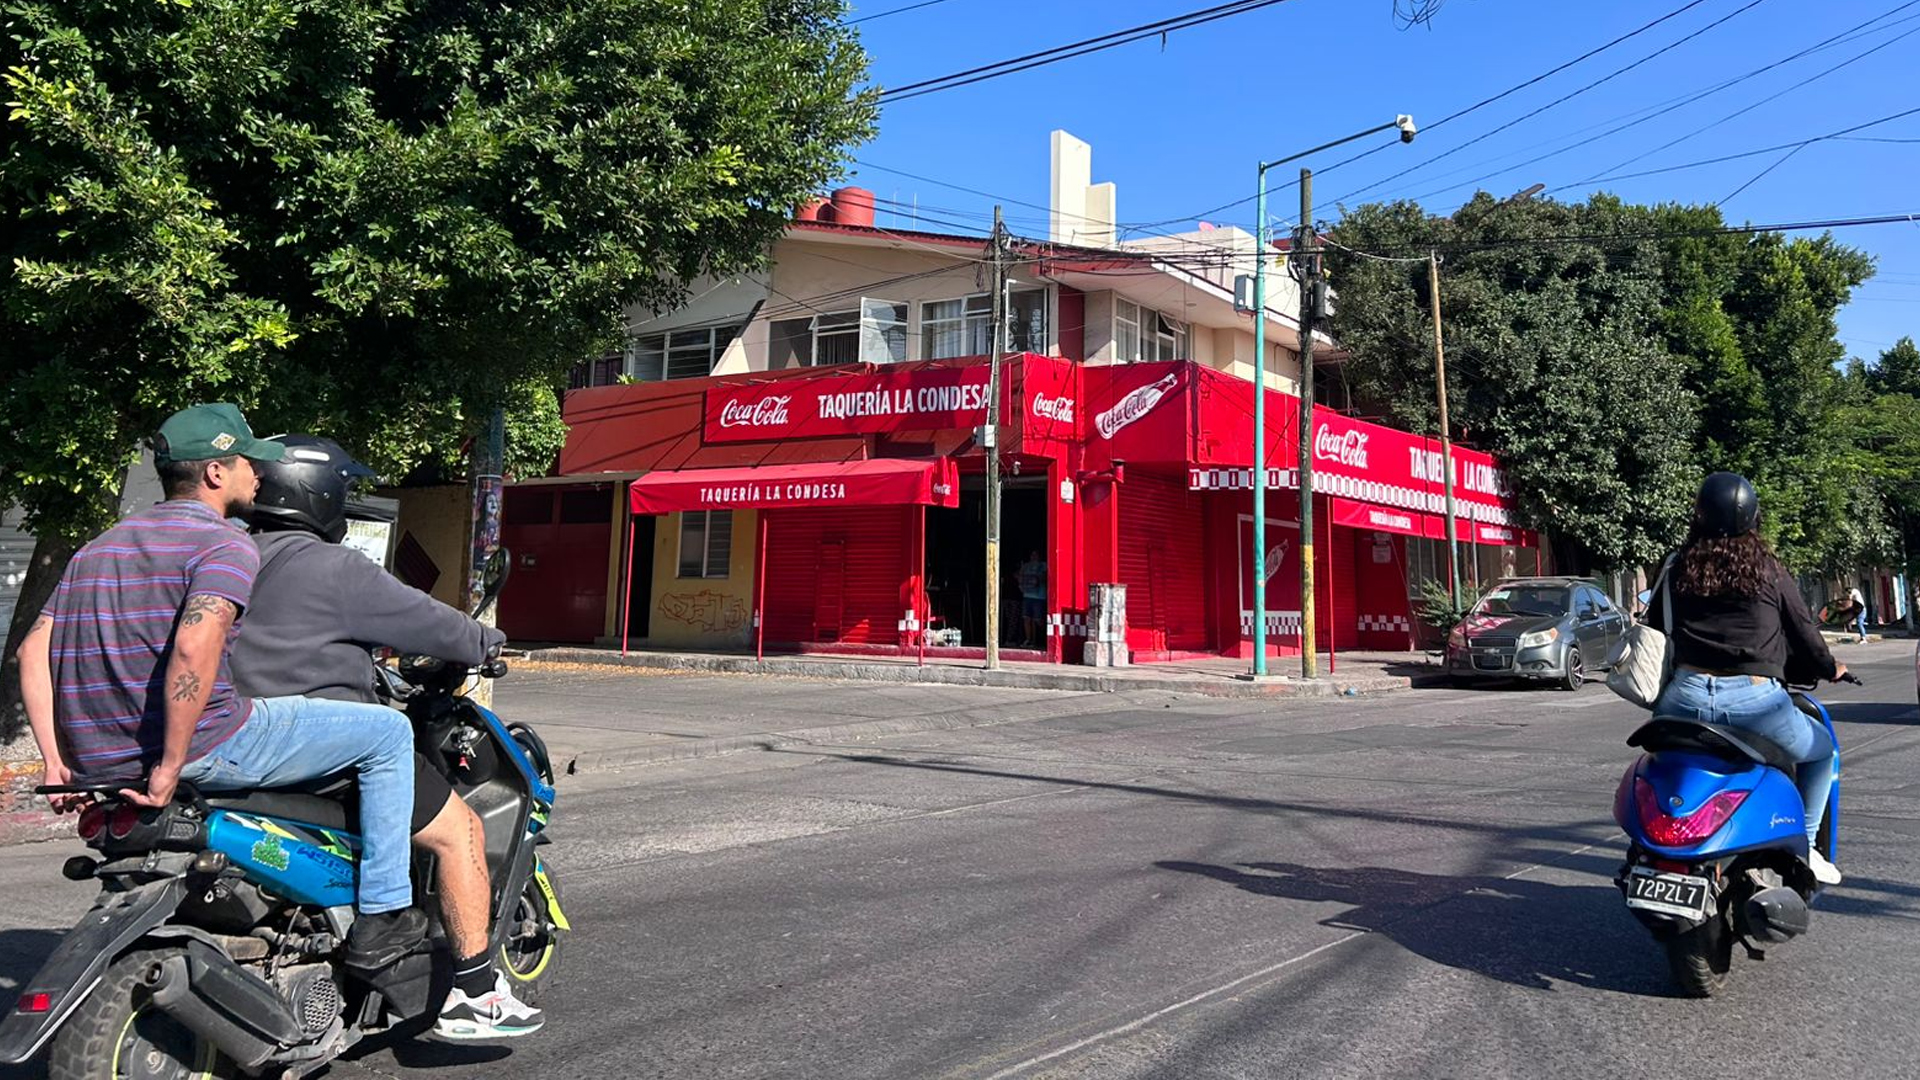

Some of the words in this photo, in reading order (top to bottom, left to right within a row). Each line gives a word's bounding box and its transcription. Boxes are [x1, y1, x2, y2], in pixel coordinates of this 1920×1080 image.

[720, 395, 792, 427] Coca-Cola
[818, 383, 891, 420] TAQUERÍA
[895, 389, 913, 414] LA
[917, 384, 991, 413] CONDESA
[1033, 392, 1075, 423] Coca-Cola
[1315, 423, 1369, 470] Coca-Cola
[1409, 446, 1457, 487] TAQUEA
[1464, 460, 1476, 491] LA
[700, 483, 760, 503] TAQUERÍA
[766, 485, 780, 500] LA
[786, 483, 845, 500] CONDESA
[1636, 877, 1697, 905] 72PZL7
